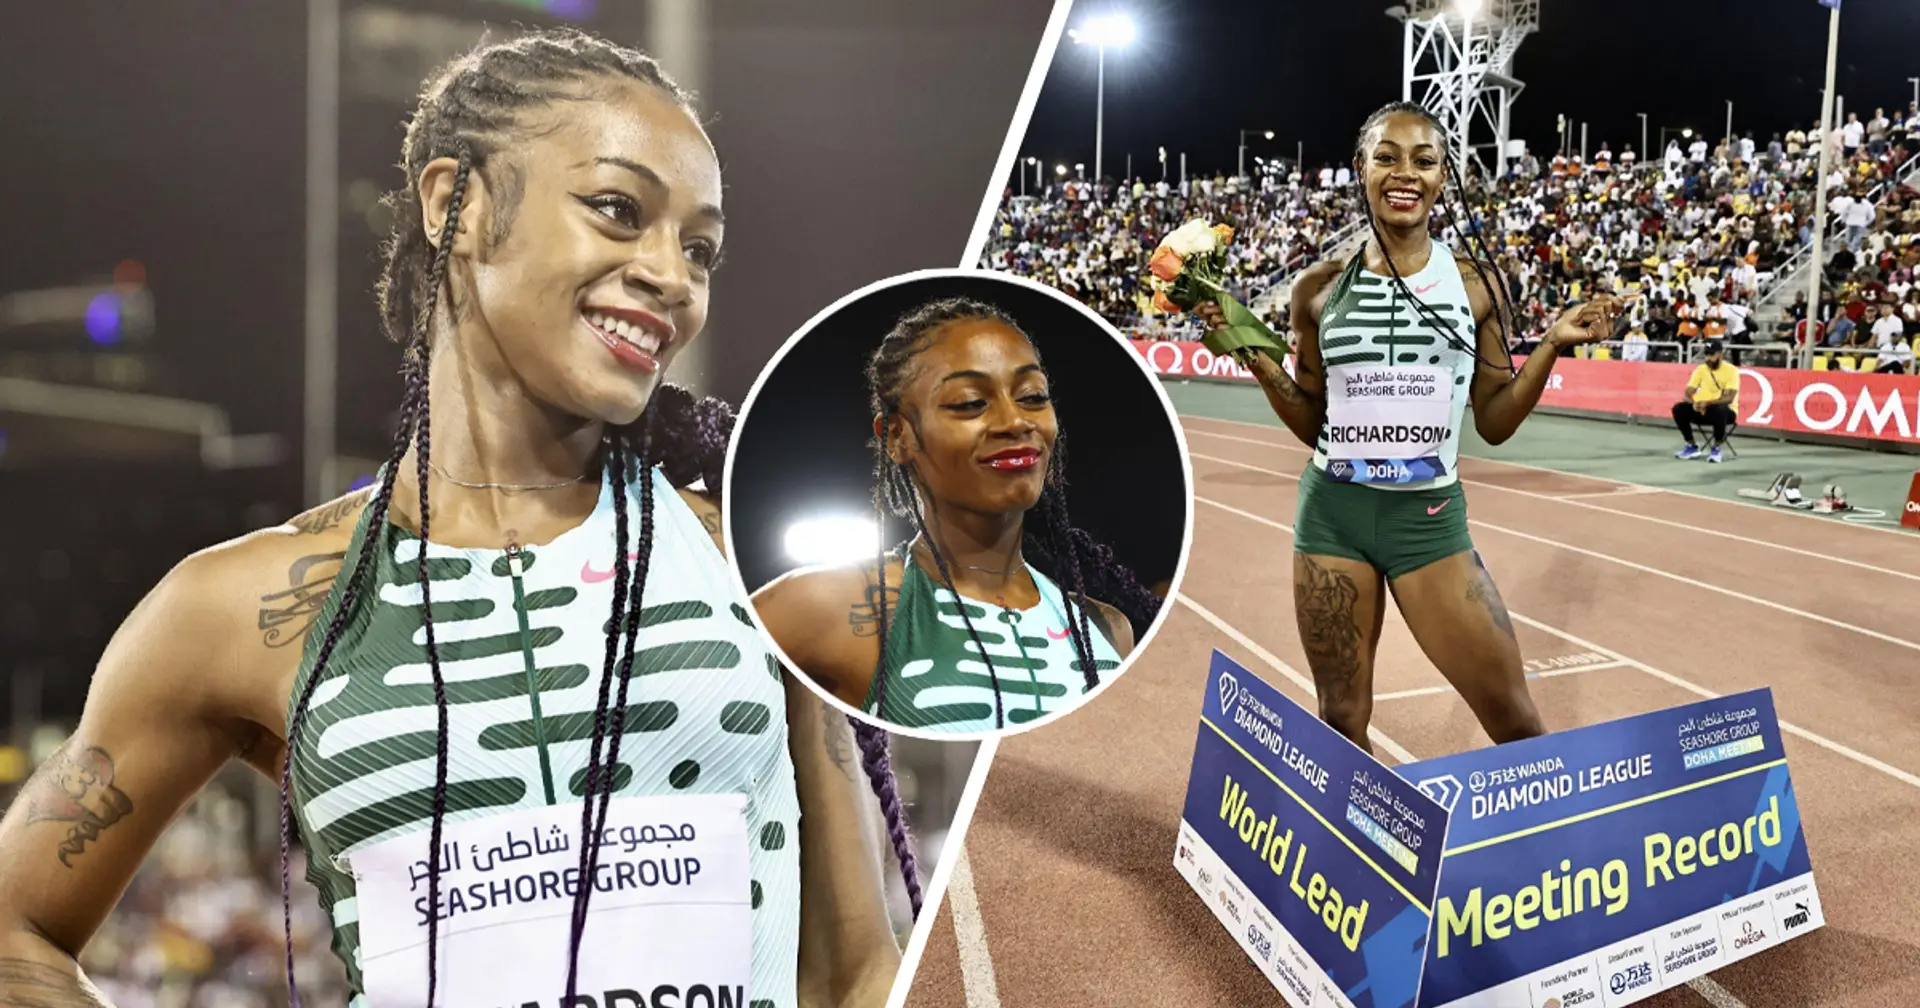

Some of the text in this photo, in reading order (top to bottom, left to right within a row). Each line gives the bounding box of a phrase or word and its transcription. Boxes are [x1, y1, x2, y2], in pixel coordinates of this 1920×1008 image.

[1346, 386, 1435, 397] SEASHORE GROUP
[1331, 425, 1445, 443] RICHARDSON
[1366, 465, 1412, 478] DOHA
[1234, 706, 1329, 793] DIAMOND LEAGUE
[1679, 721, 1760, 752] SEASHORE GROUP
[1684, 751, 1716, 769] DOHA
[1472, 754, 1653, 820] DIAMOND LEAGUE
[471, 824, 569, 872] شاطئ
[1390, 818, 1422, 850] GROUP
[408, 841, 461, 891] الحر
[1219, 774, 1370, 952] World Lead
[1436, 796, 1782, 959] Meeting Record
[414, 857, 700, 926] SEASHORE GROUP
[1734, 929, 1766, 949] OMEGA
